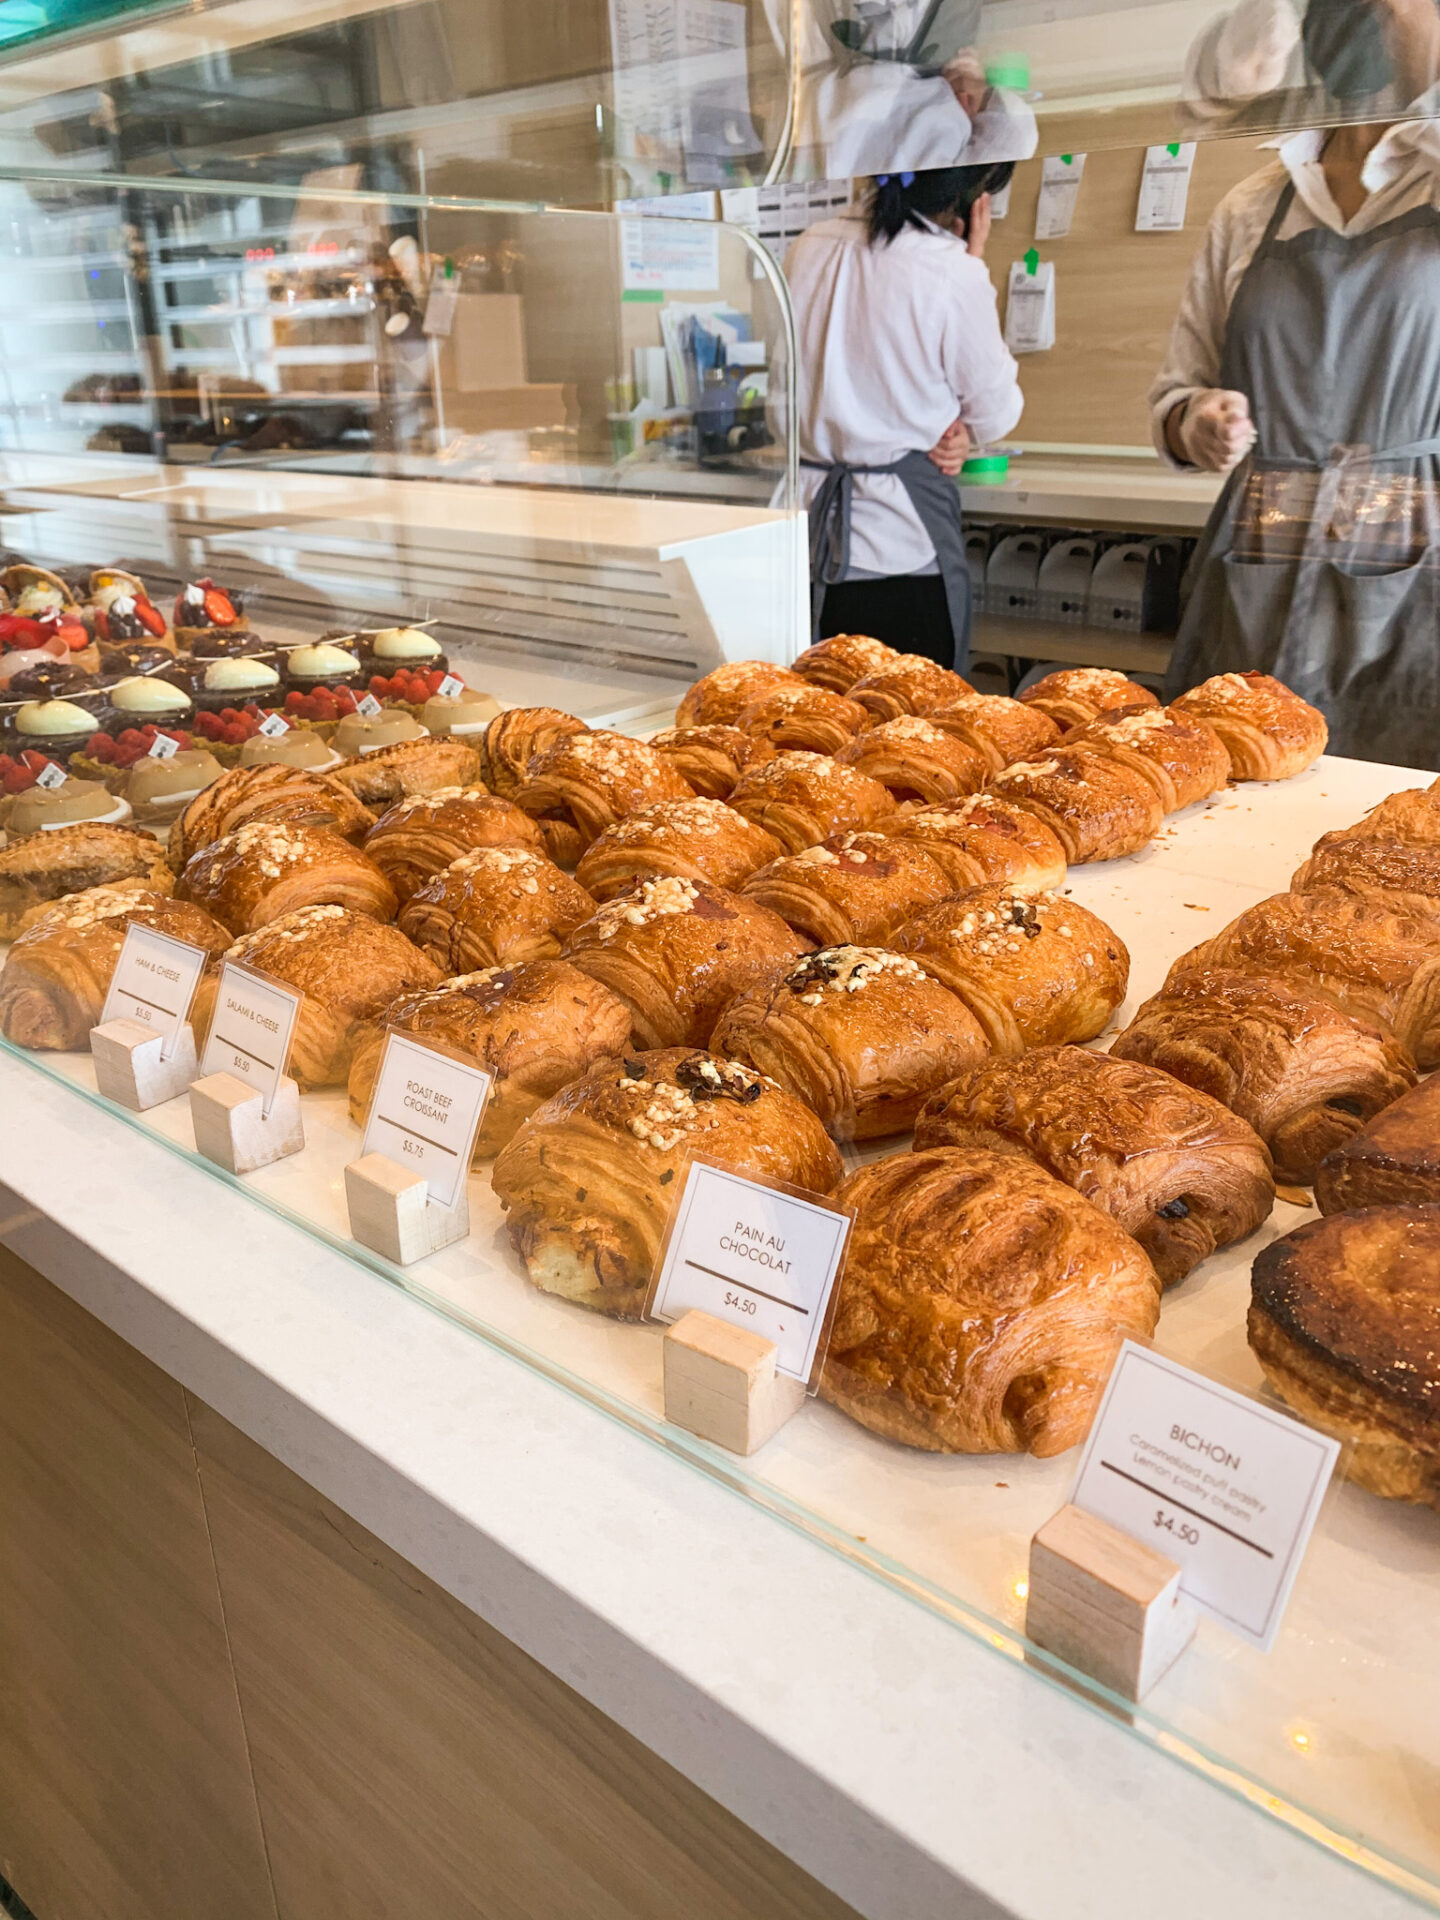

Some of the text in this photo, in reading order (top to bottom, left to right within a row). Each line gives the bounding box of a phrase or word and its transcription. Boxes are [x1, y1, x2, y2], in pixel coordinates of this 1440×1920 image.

[135, 956, 181, 983] HAM & CHEESE
[227, 998, 280, 1034] SALAMI & CHEESE
[233, 1057, 250, 1072] $5.50
[406, 1080, 453, 1108] ROAST BEEF
[403, 1096, 448, 1124] CROISSANT
[402, 1140, 424, 1158] $5.75
[735, 1222, 785, 1252] PAIN AU
[719, 1237, 792, 1275] CHOCOLAT
[724, 1292, 757, 1315] $4.50
[1169, 1425, 1241, 1470] BICHON
[1130, 1434, 1267, 1513] Caramelized puff pastry
[1133, 1452, 1252, 1521] Lemon pastry cream
[1152, 1511, 1200, 1545] $4.50
